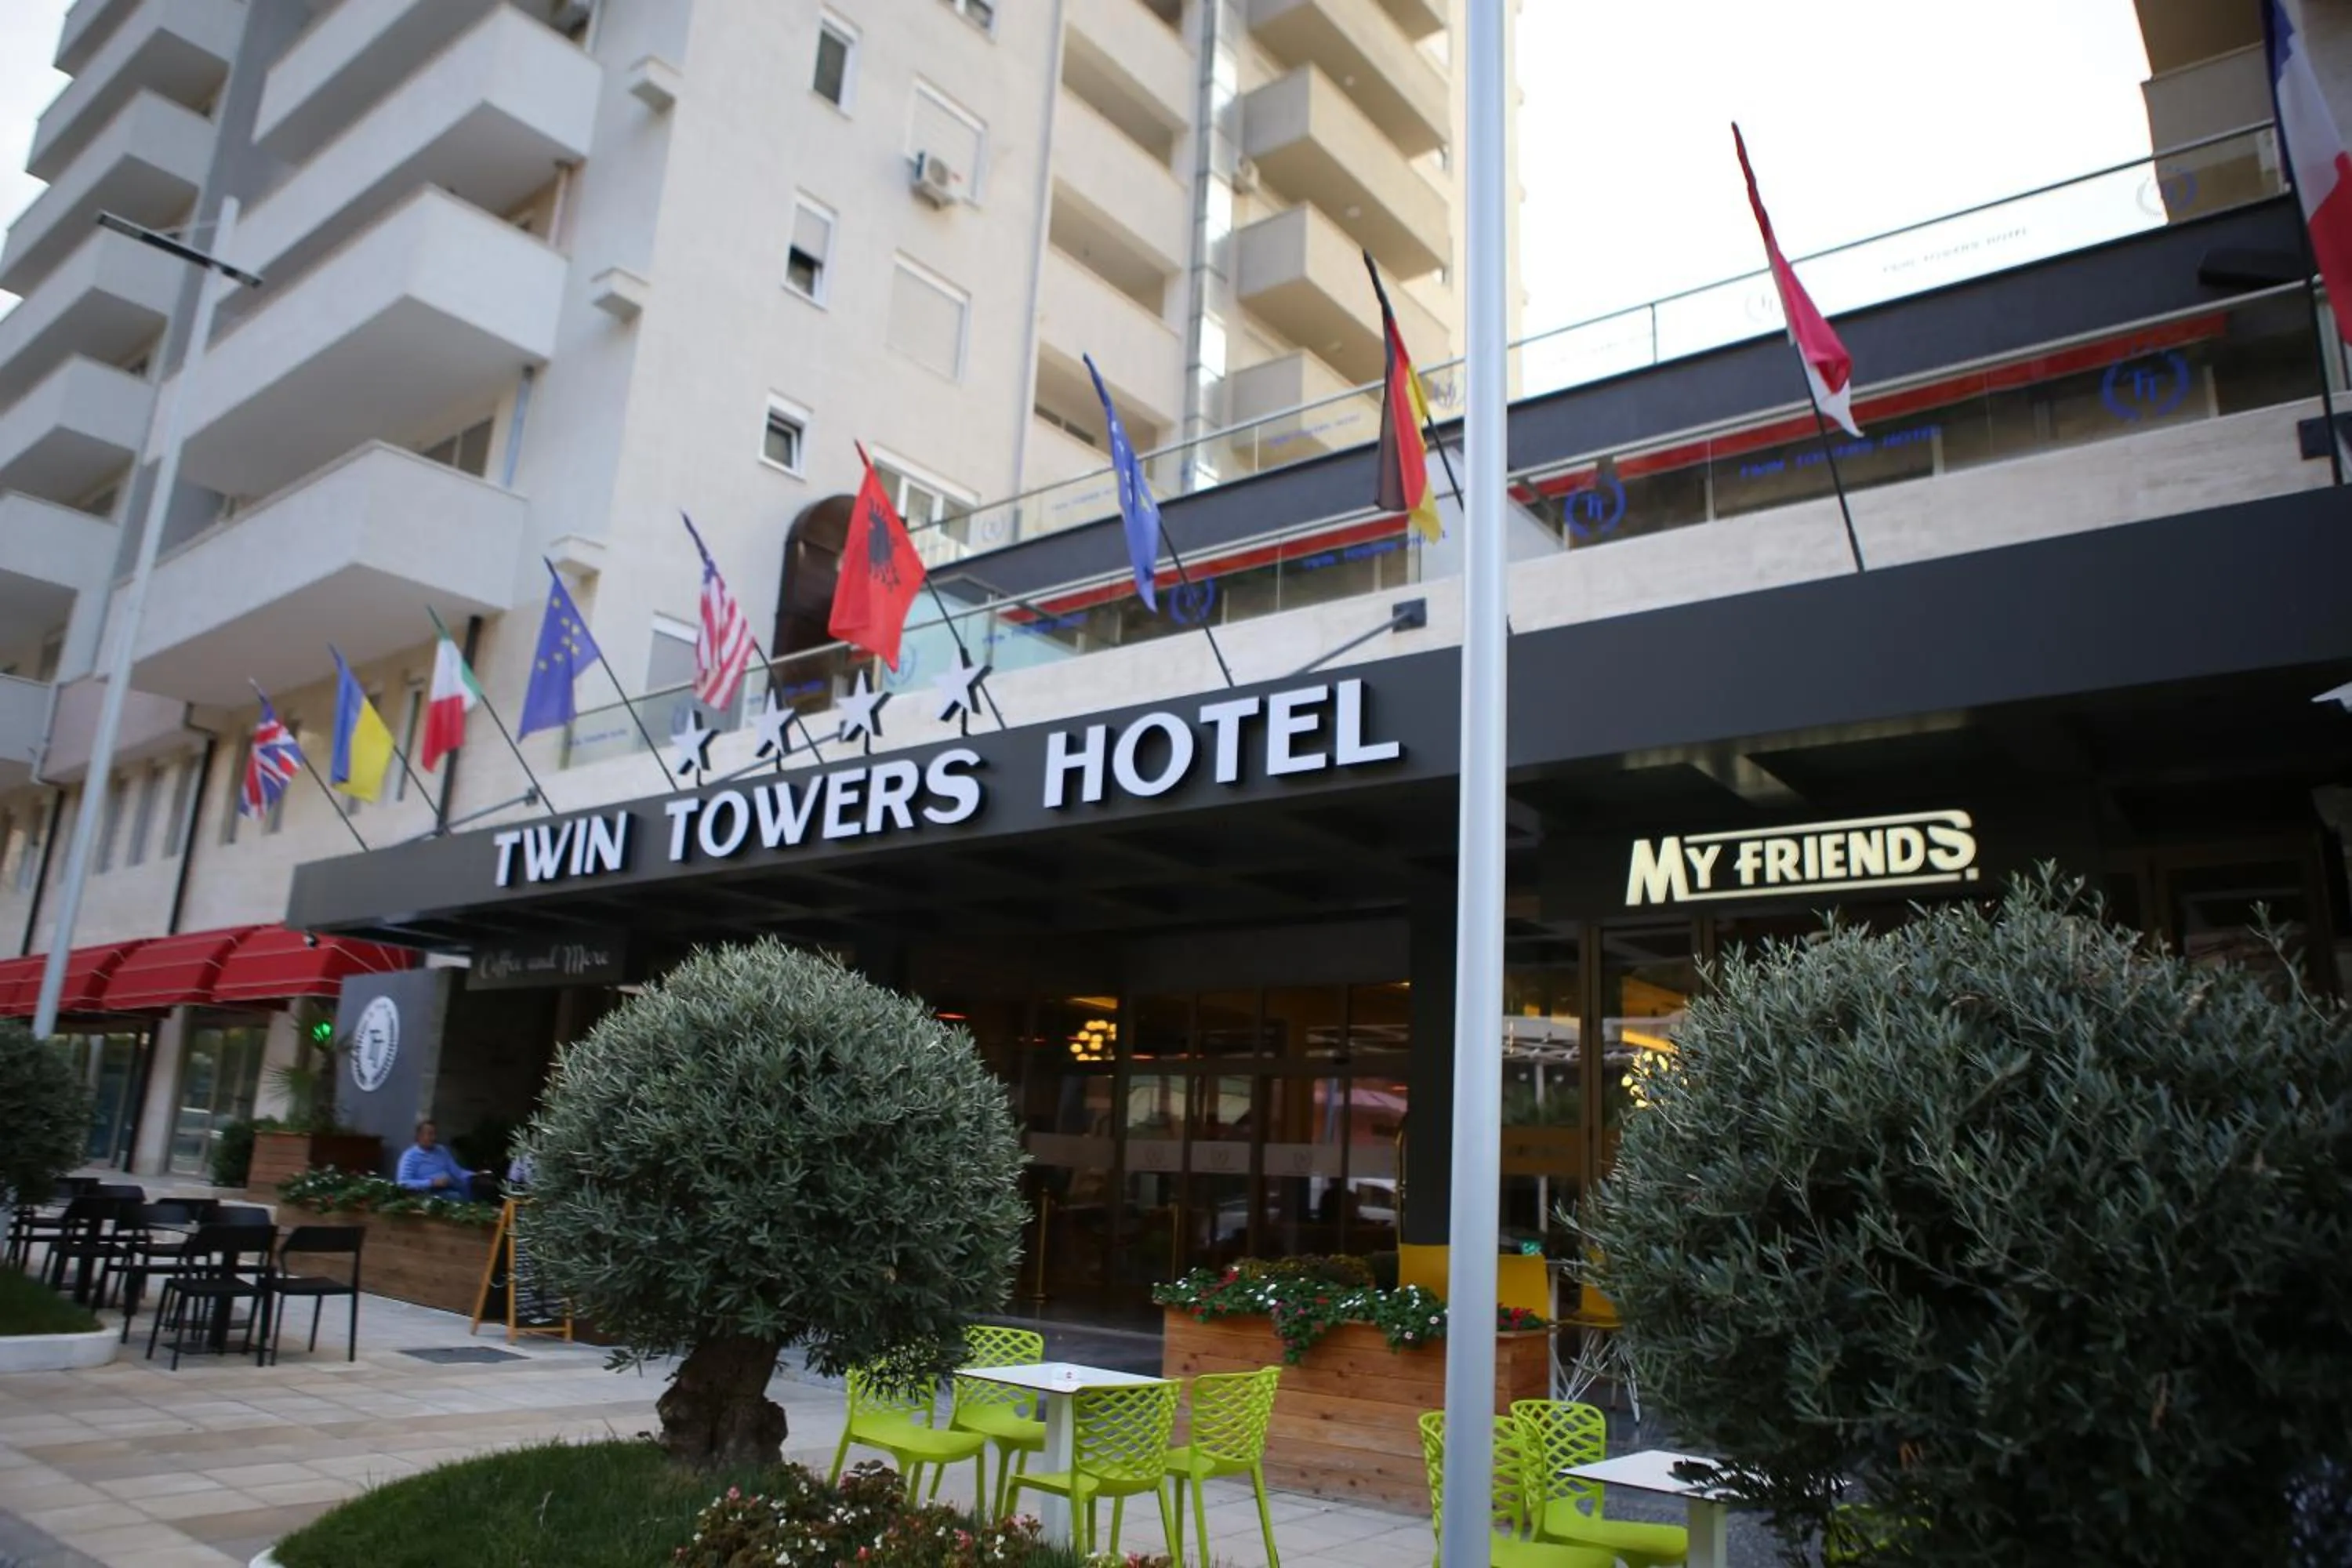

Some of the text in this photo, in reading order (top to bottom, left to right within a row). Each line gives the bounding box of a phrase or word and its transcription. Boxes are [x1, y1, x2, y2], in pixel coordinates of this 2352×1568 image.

[494, 678, 1401, 887] TWIN TOWERS HOTEL
[1625, 836, 1722, 906] MY
